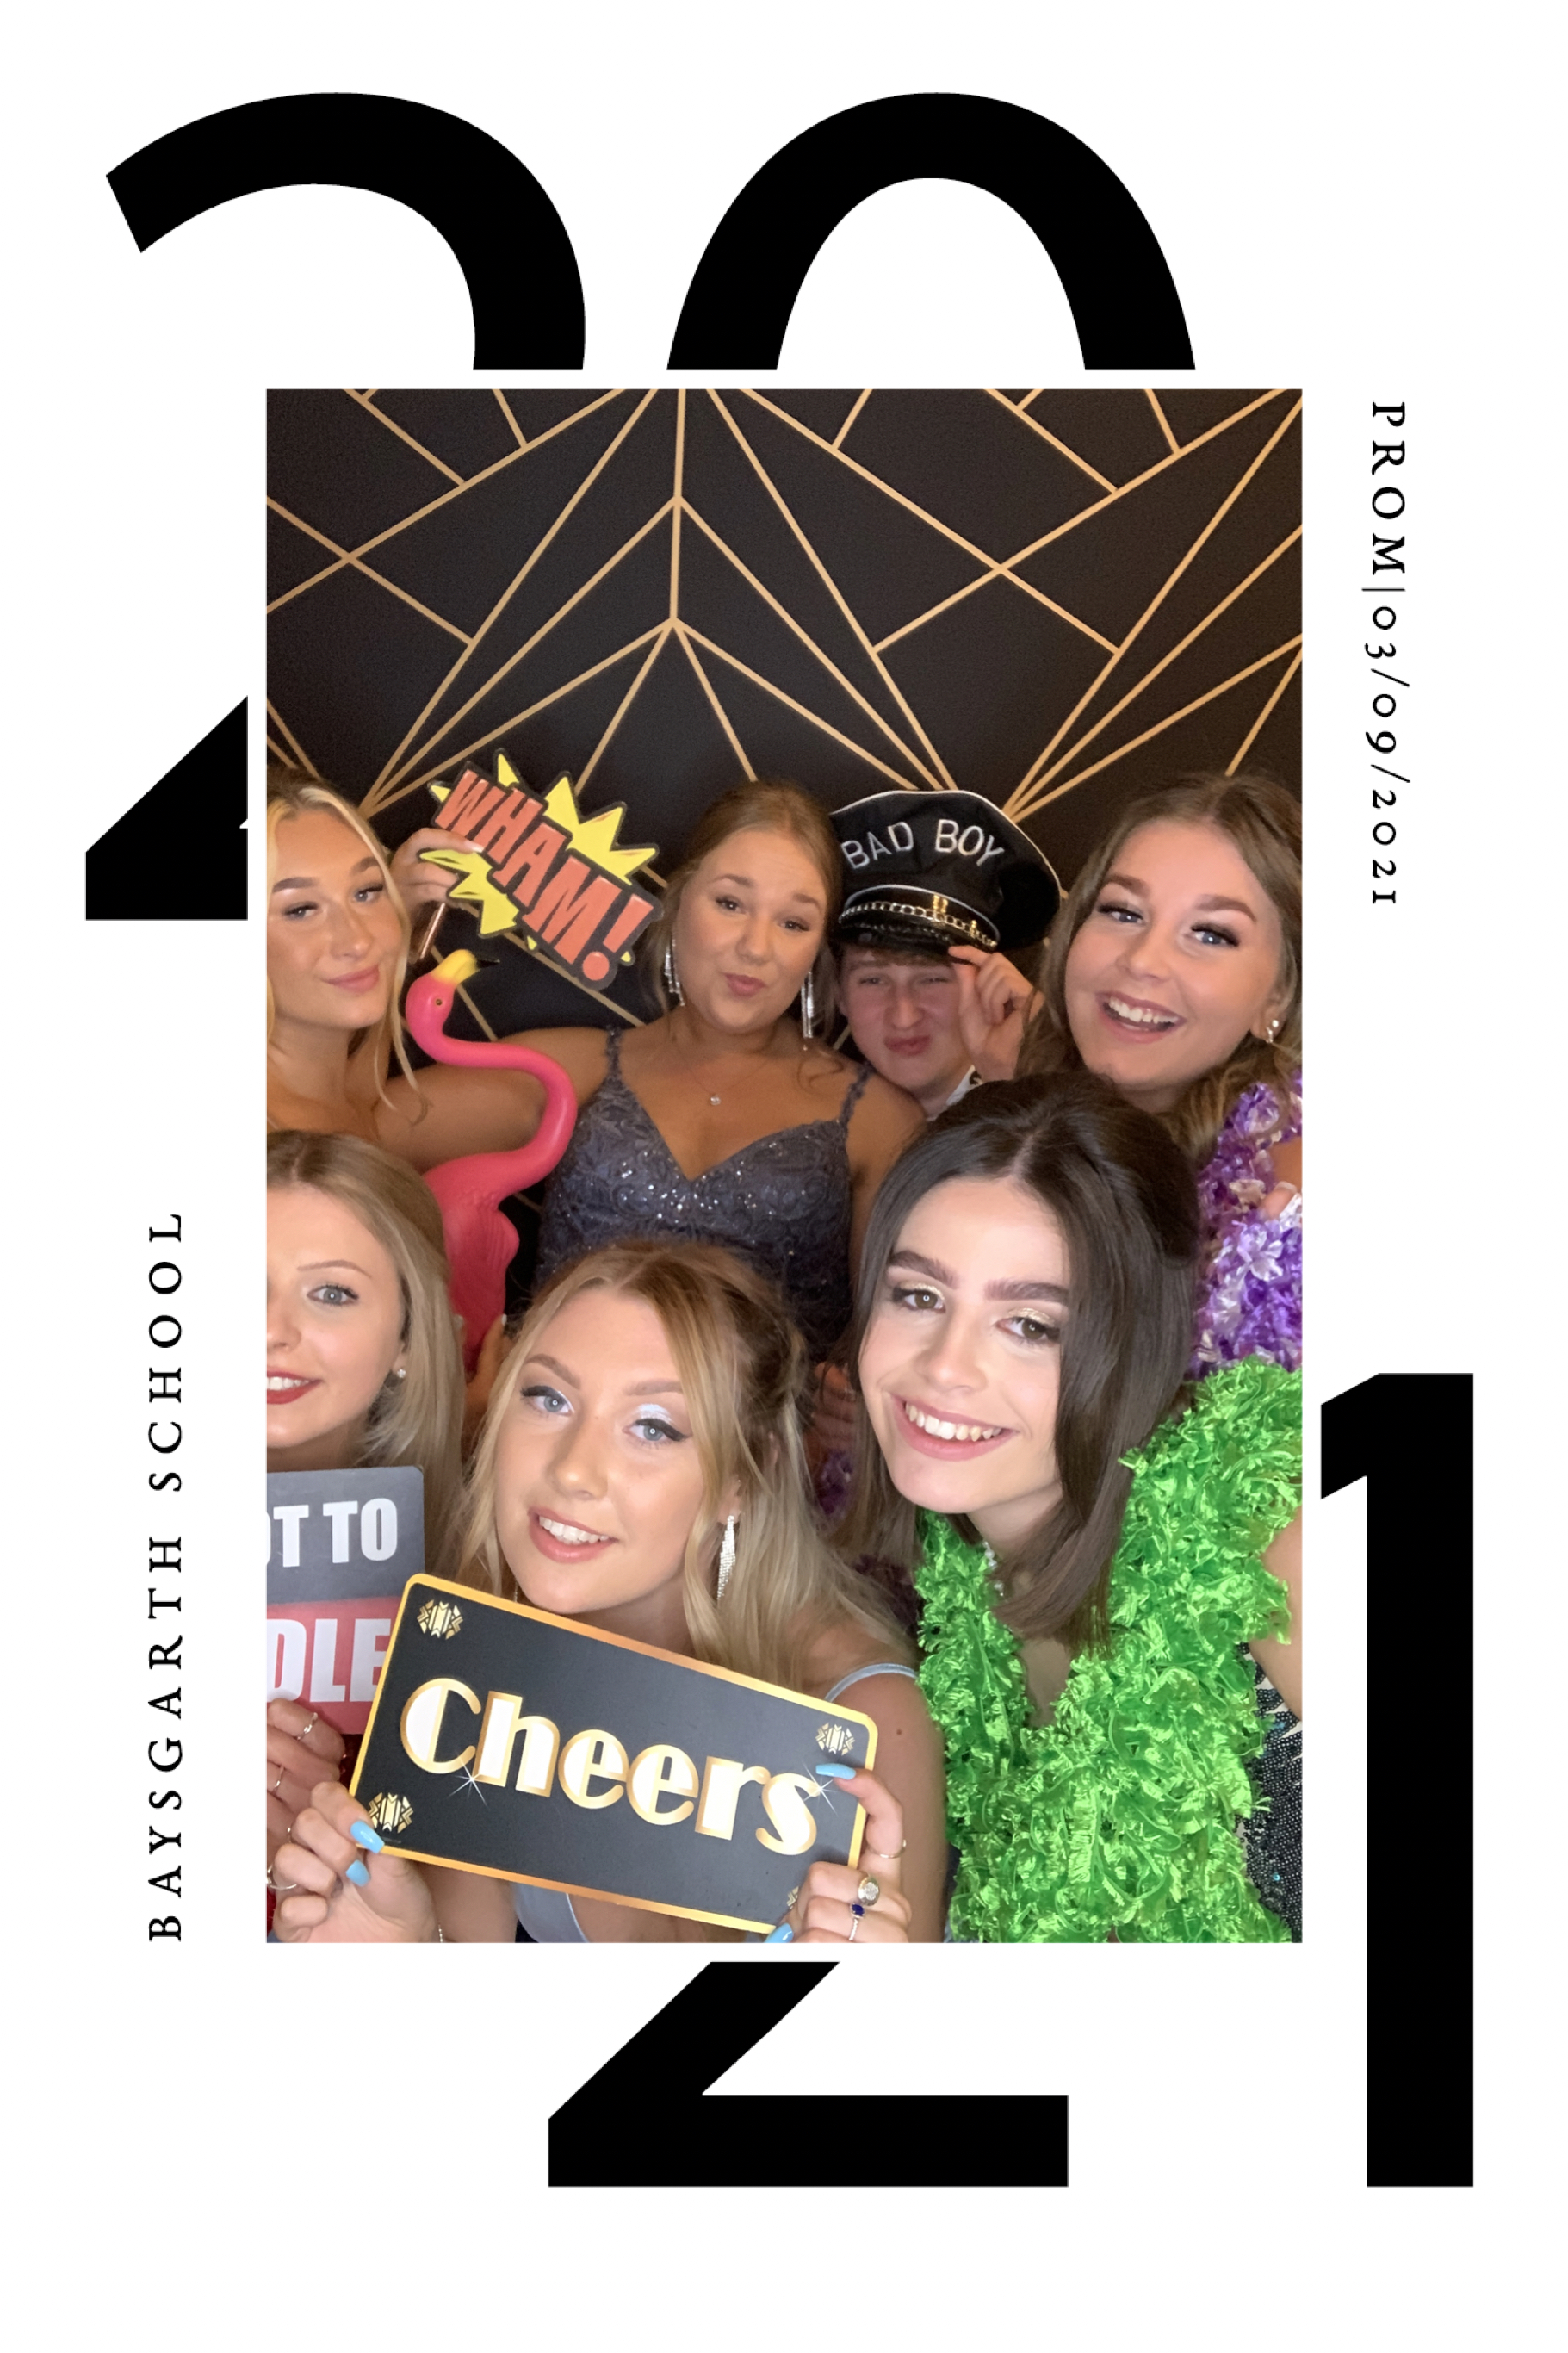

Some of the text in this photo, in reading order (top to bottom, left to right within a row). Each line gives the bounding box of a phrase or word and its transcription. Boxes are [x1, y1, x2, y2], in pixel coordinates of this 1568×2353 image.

[435, 769, 654, 981] WHAM!
[841, 819, 1004, 869] BAD BOY
[267, 1498, 397, 1567] T TO
[400, 1678, 821, 1855] Cheers
